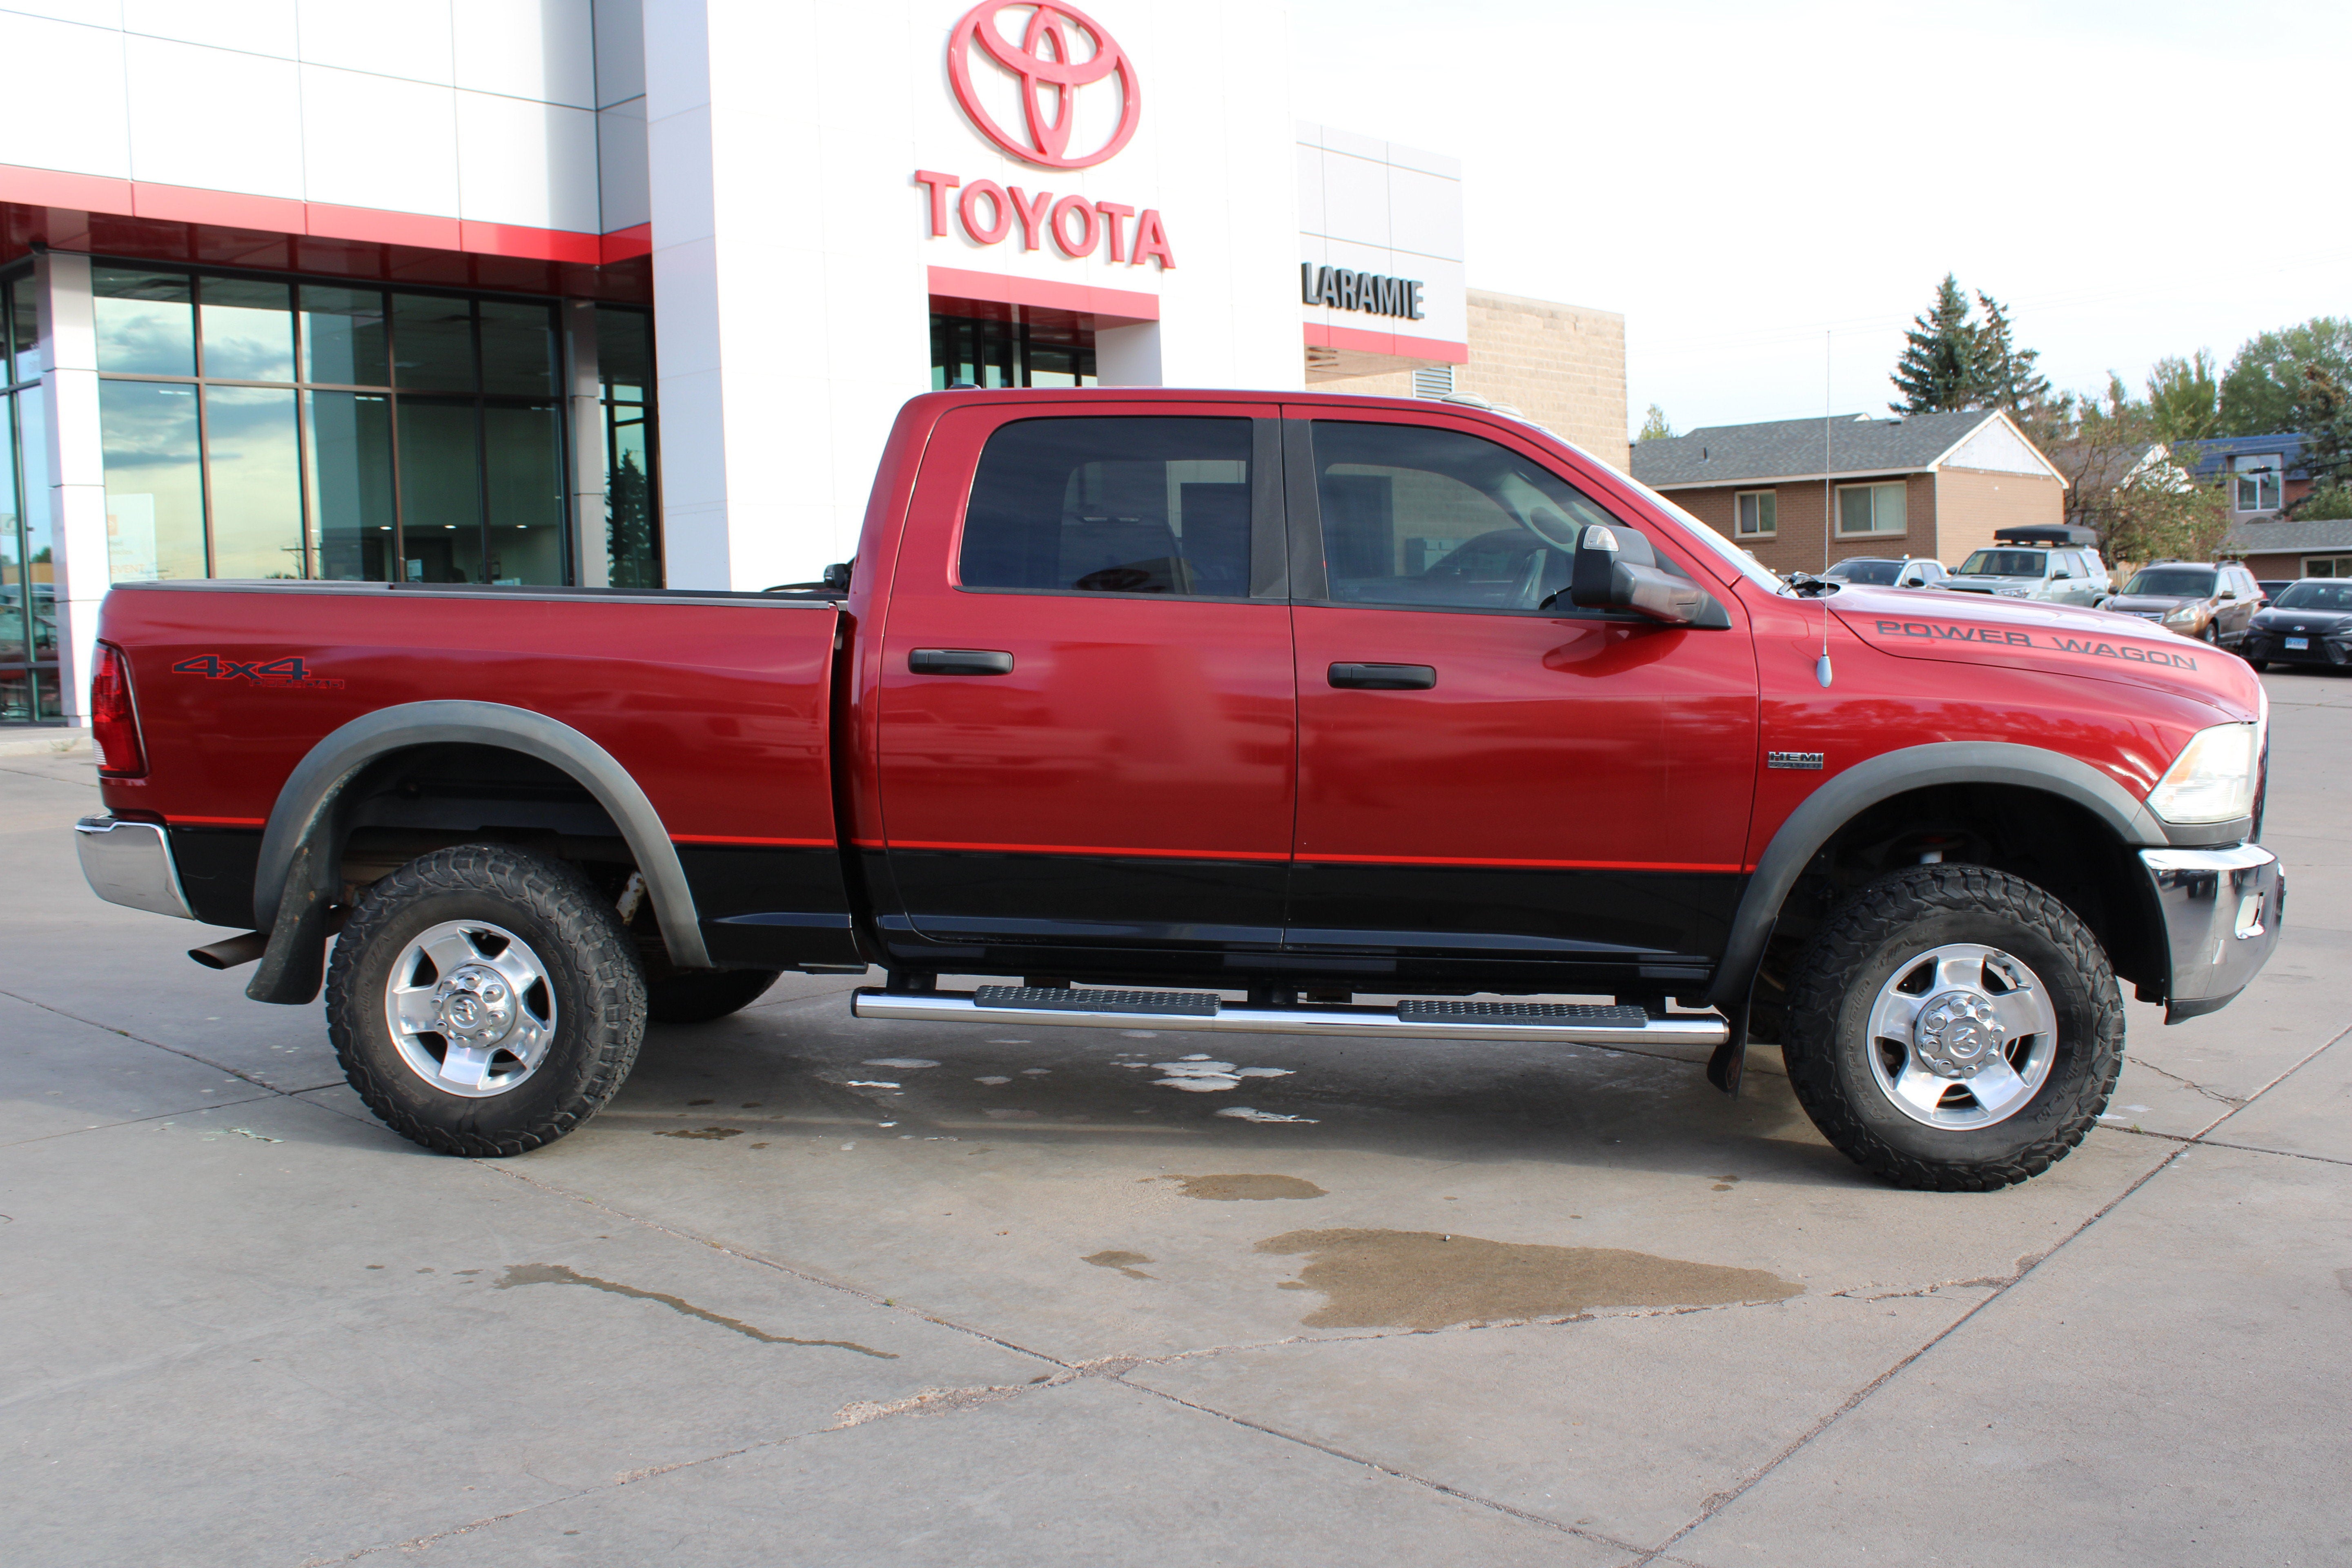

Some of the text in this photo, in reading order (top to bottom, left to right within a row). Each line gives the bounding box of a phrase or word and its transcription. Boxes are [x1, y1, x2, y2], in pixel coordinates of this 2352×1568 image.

[915, 169, 1176, 269] TOYOTA
[1301, 261, 1425, 320] LARAMIE
[172, 654, 311, 679] 4x4
[1876, 620, 2197, 671] POWER WAGON
[1768, 751, 1824, 762] HEMI
